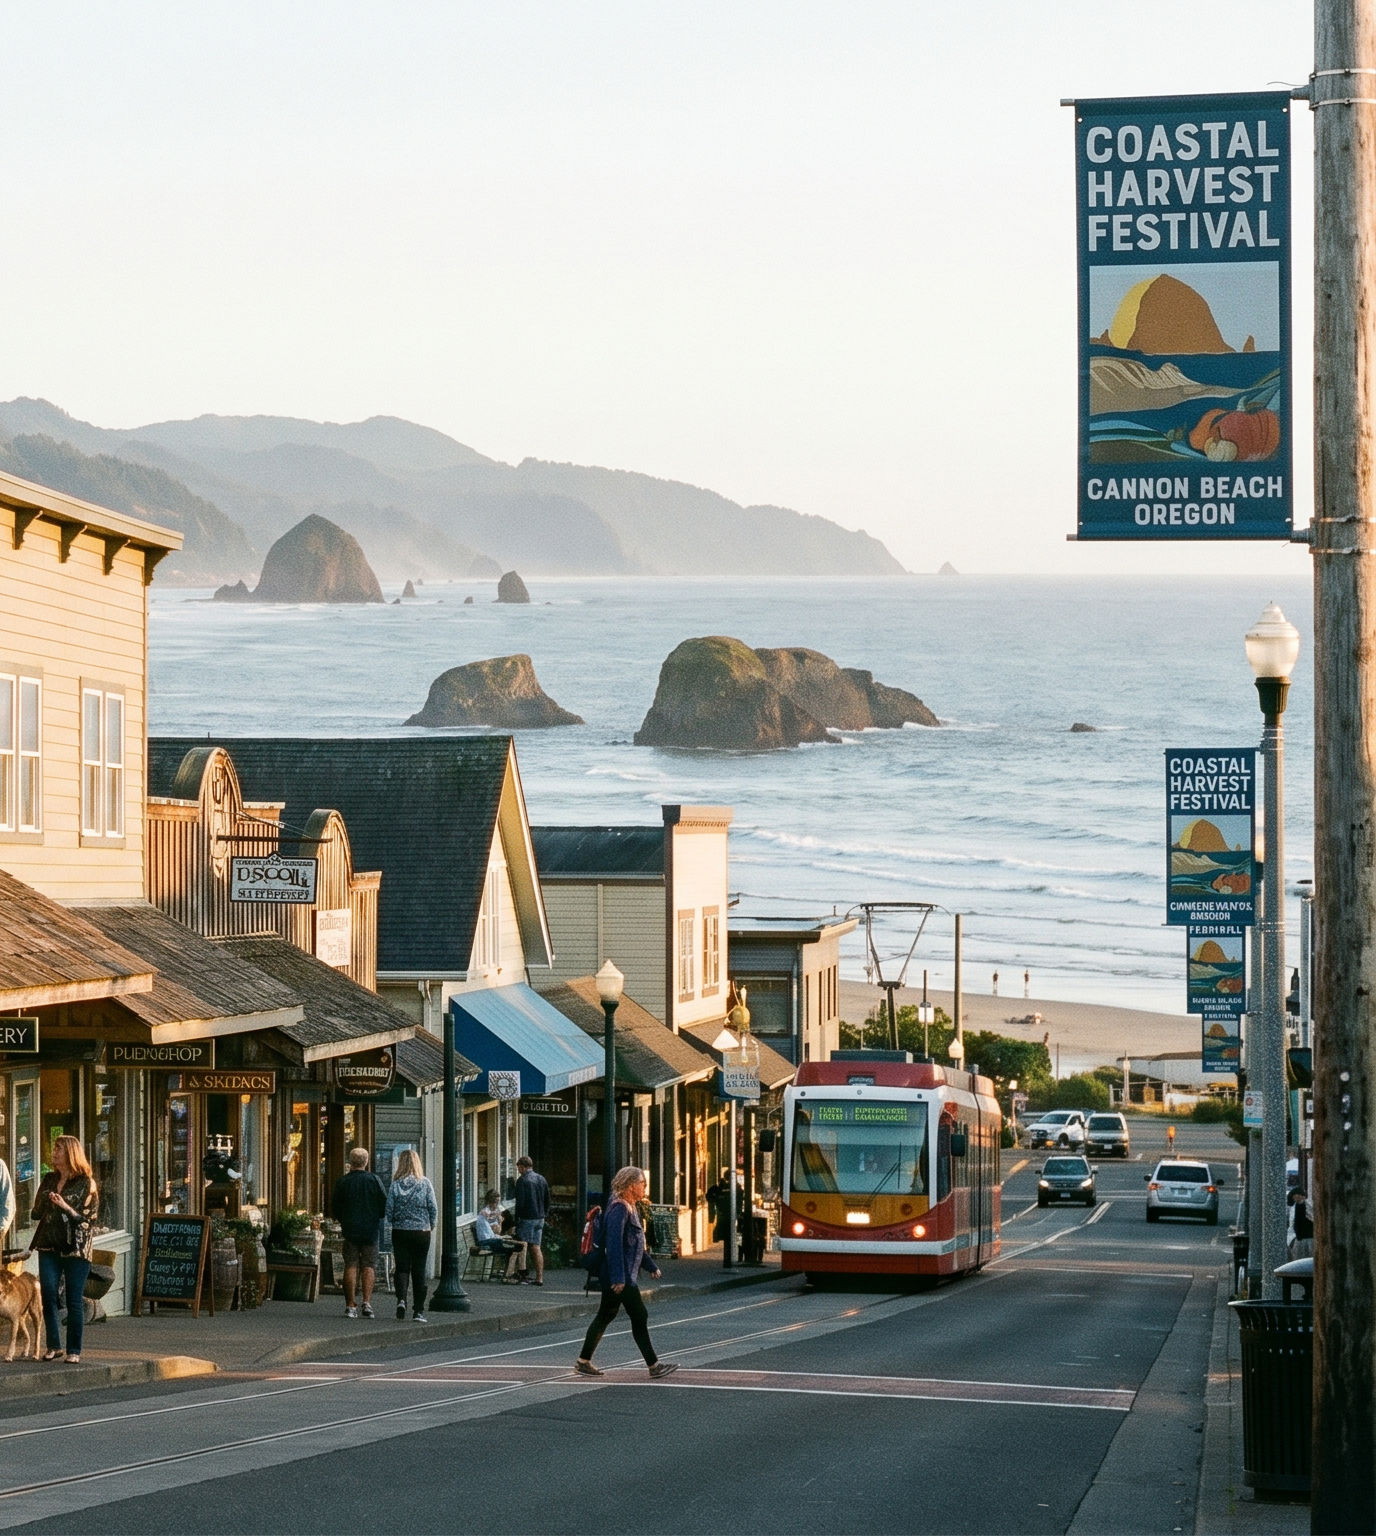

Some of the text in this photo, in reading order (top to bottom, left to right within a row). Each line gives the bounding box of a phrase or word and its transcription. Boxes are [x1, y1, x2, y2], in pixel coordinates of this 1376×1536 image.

[1086, 120, 1280, 164] COASTAL
[1087, 164, 1280, 208] HARVEST
[1088, 209, 1280, 252] FESTIVAL
[1087, 475, 1283, 501] CANNON BEACH
[1134, 502, 1235, 526] OREGON
[1169, 757, 1251, 774] COASTAL
[1170, 775, 1251, 792] HARVEST
[1170, 793, 1251, 810] FESTIVAL
